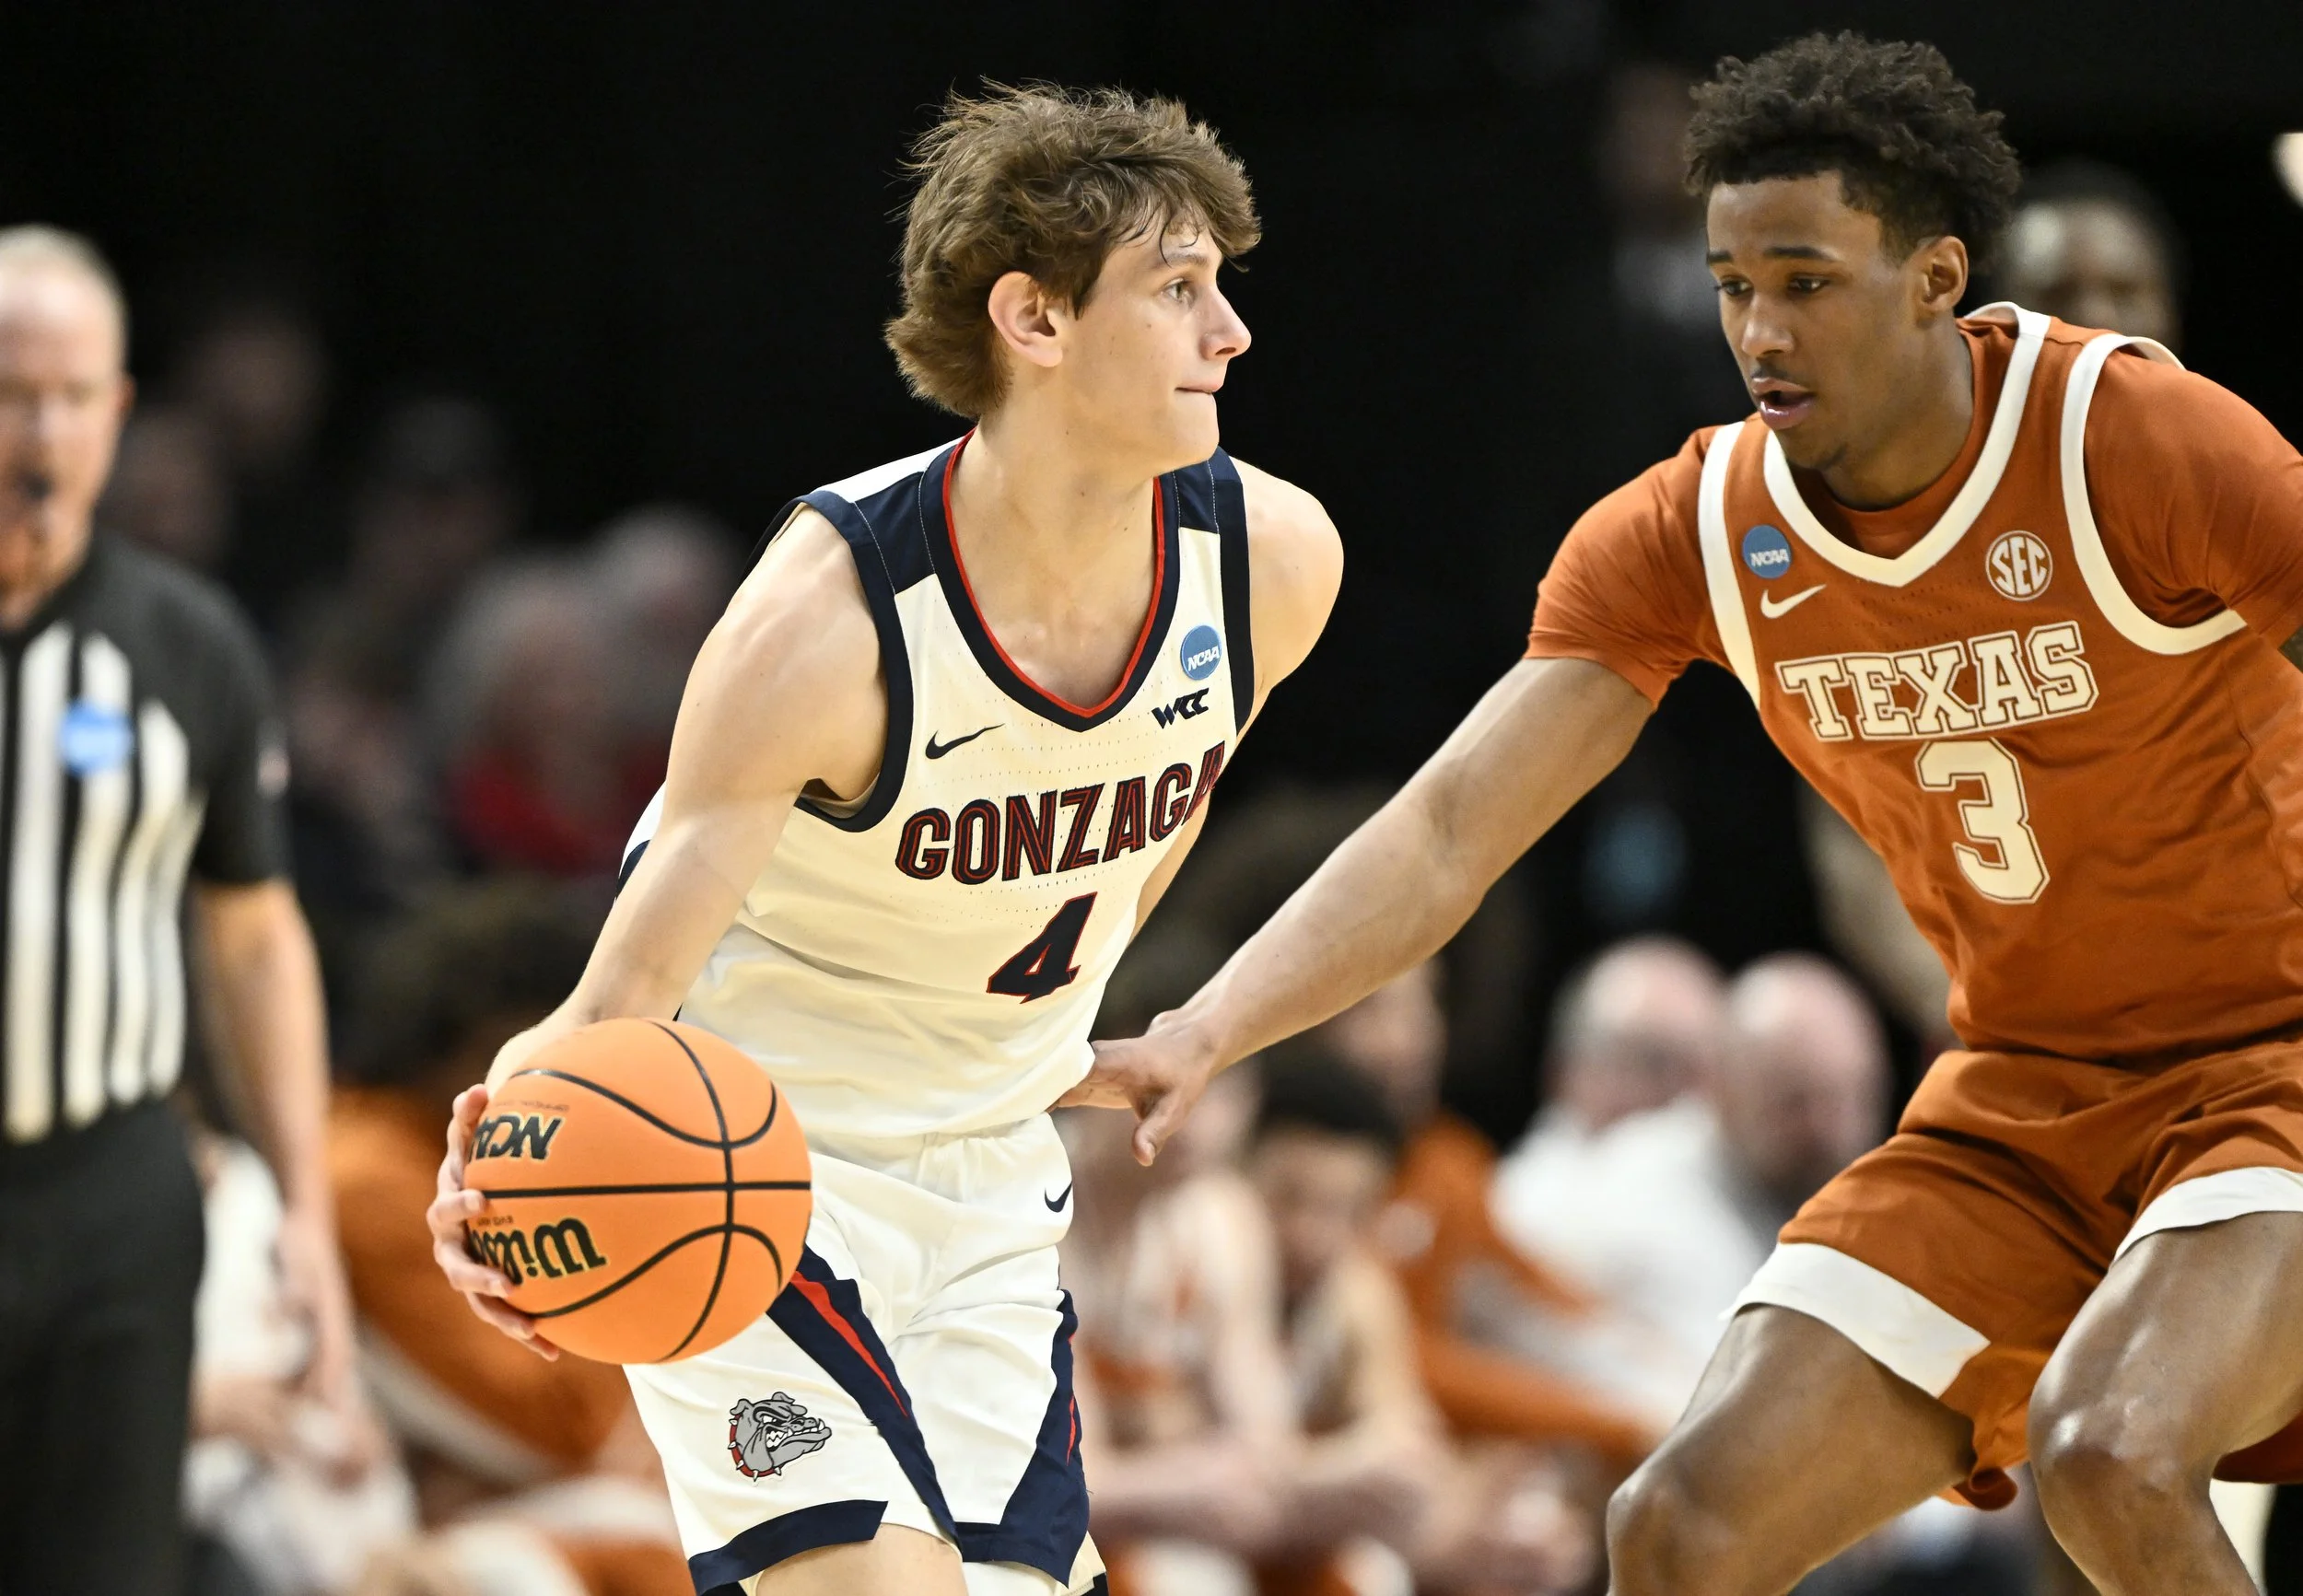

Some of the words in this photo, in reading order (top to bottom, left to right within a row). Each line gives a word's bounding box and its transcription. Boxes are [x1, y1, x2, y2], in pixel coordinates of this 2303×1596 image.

[1750, 548, 1790, 567] NCAA
[1993, 535, 2047, 597] SEC
[1187, 645, 1221, 672] NCAA
[1774, 620, 2099, 742] TEXAS
[1152, 687, 1210, 729] WCC
[894, 740, 1225, 885] GONZAGA
[1914, 737, 2051, 904] 3
[986, 891, 1098, 1004] 4
[468, 1114, 562, 1162] NCA
